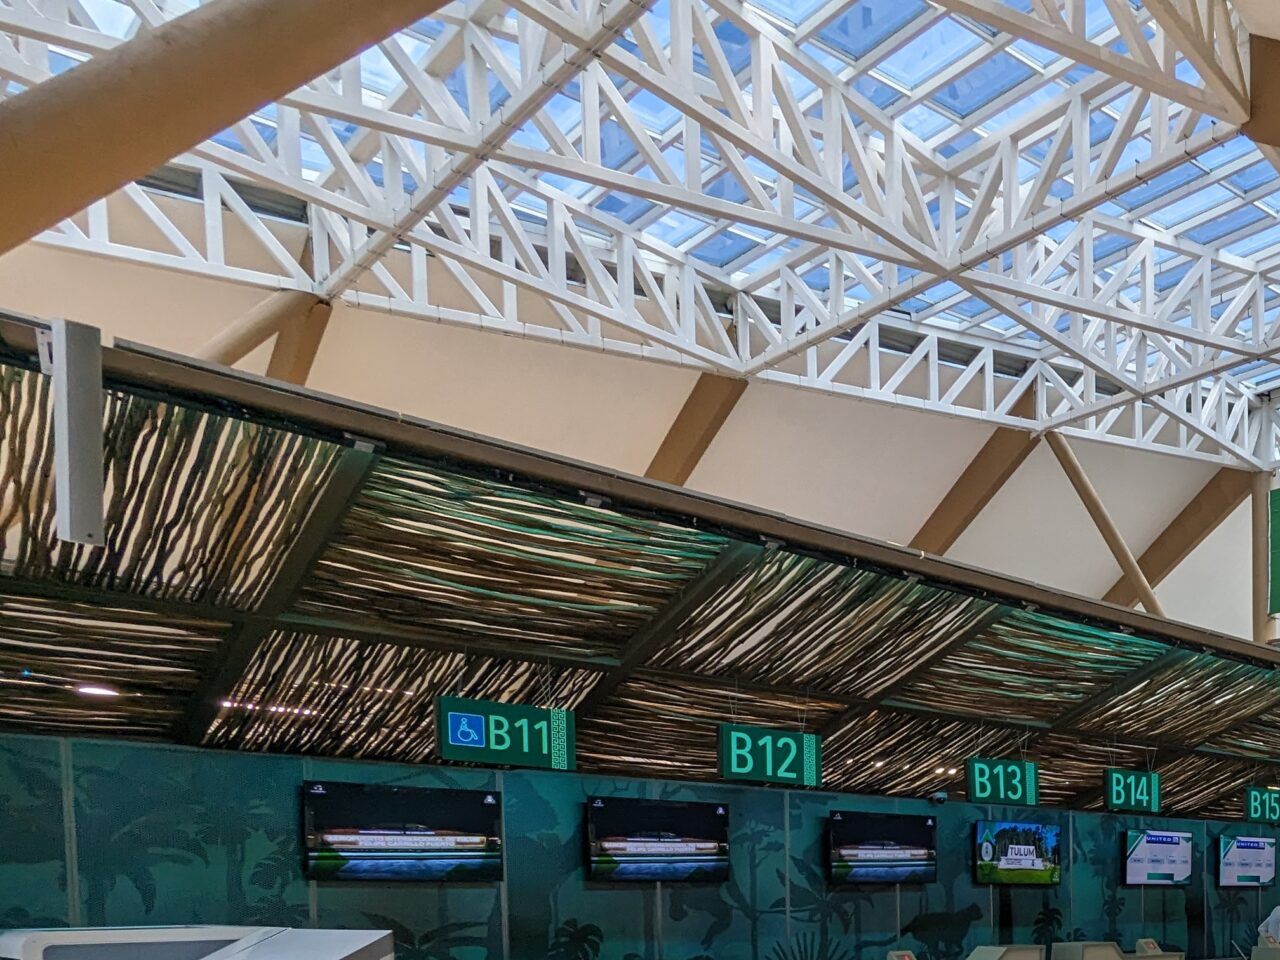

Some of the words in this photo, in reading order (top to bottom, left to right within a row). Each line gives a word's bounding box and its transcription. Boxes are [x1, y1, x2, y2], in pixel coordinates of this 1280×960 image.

[489, 714, 548, 755] B11
[731, 731, 797, 779] B12
[974, 763, 1022, 799] B13
[1112, 772, 1149, 807] B14
[1250, 790, 1280, 820] B15
[1009, 846, 1035, 857] TULUM
